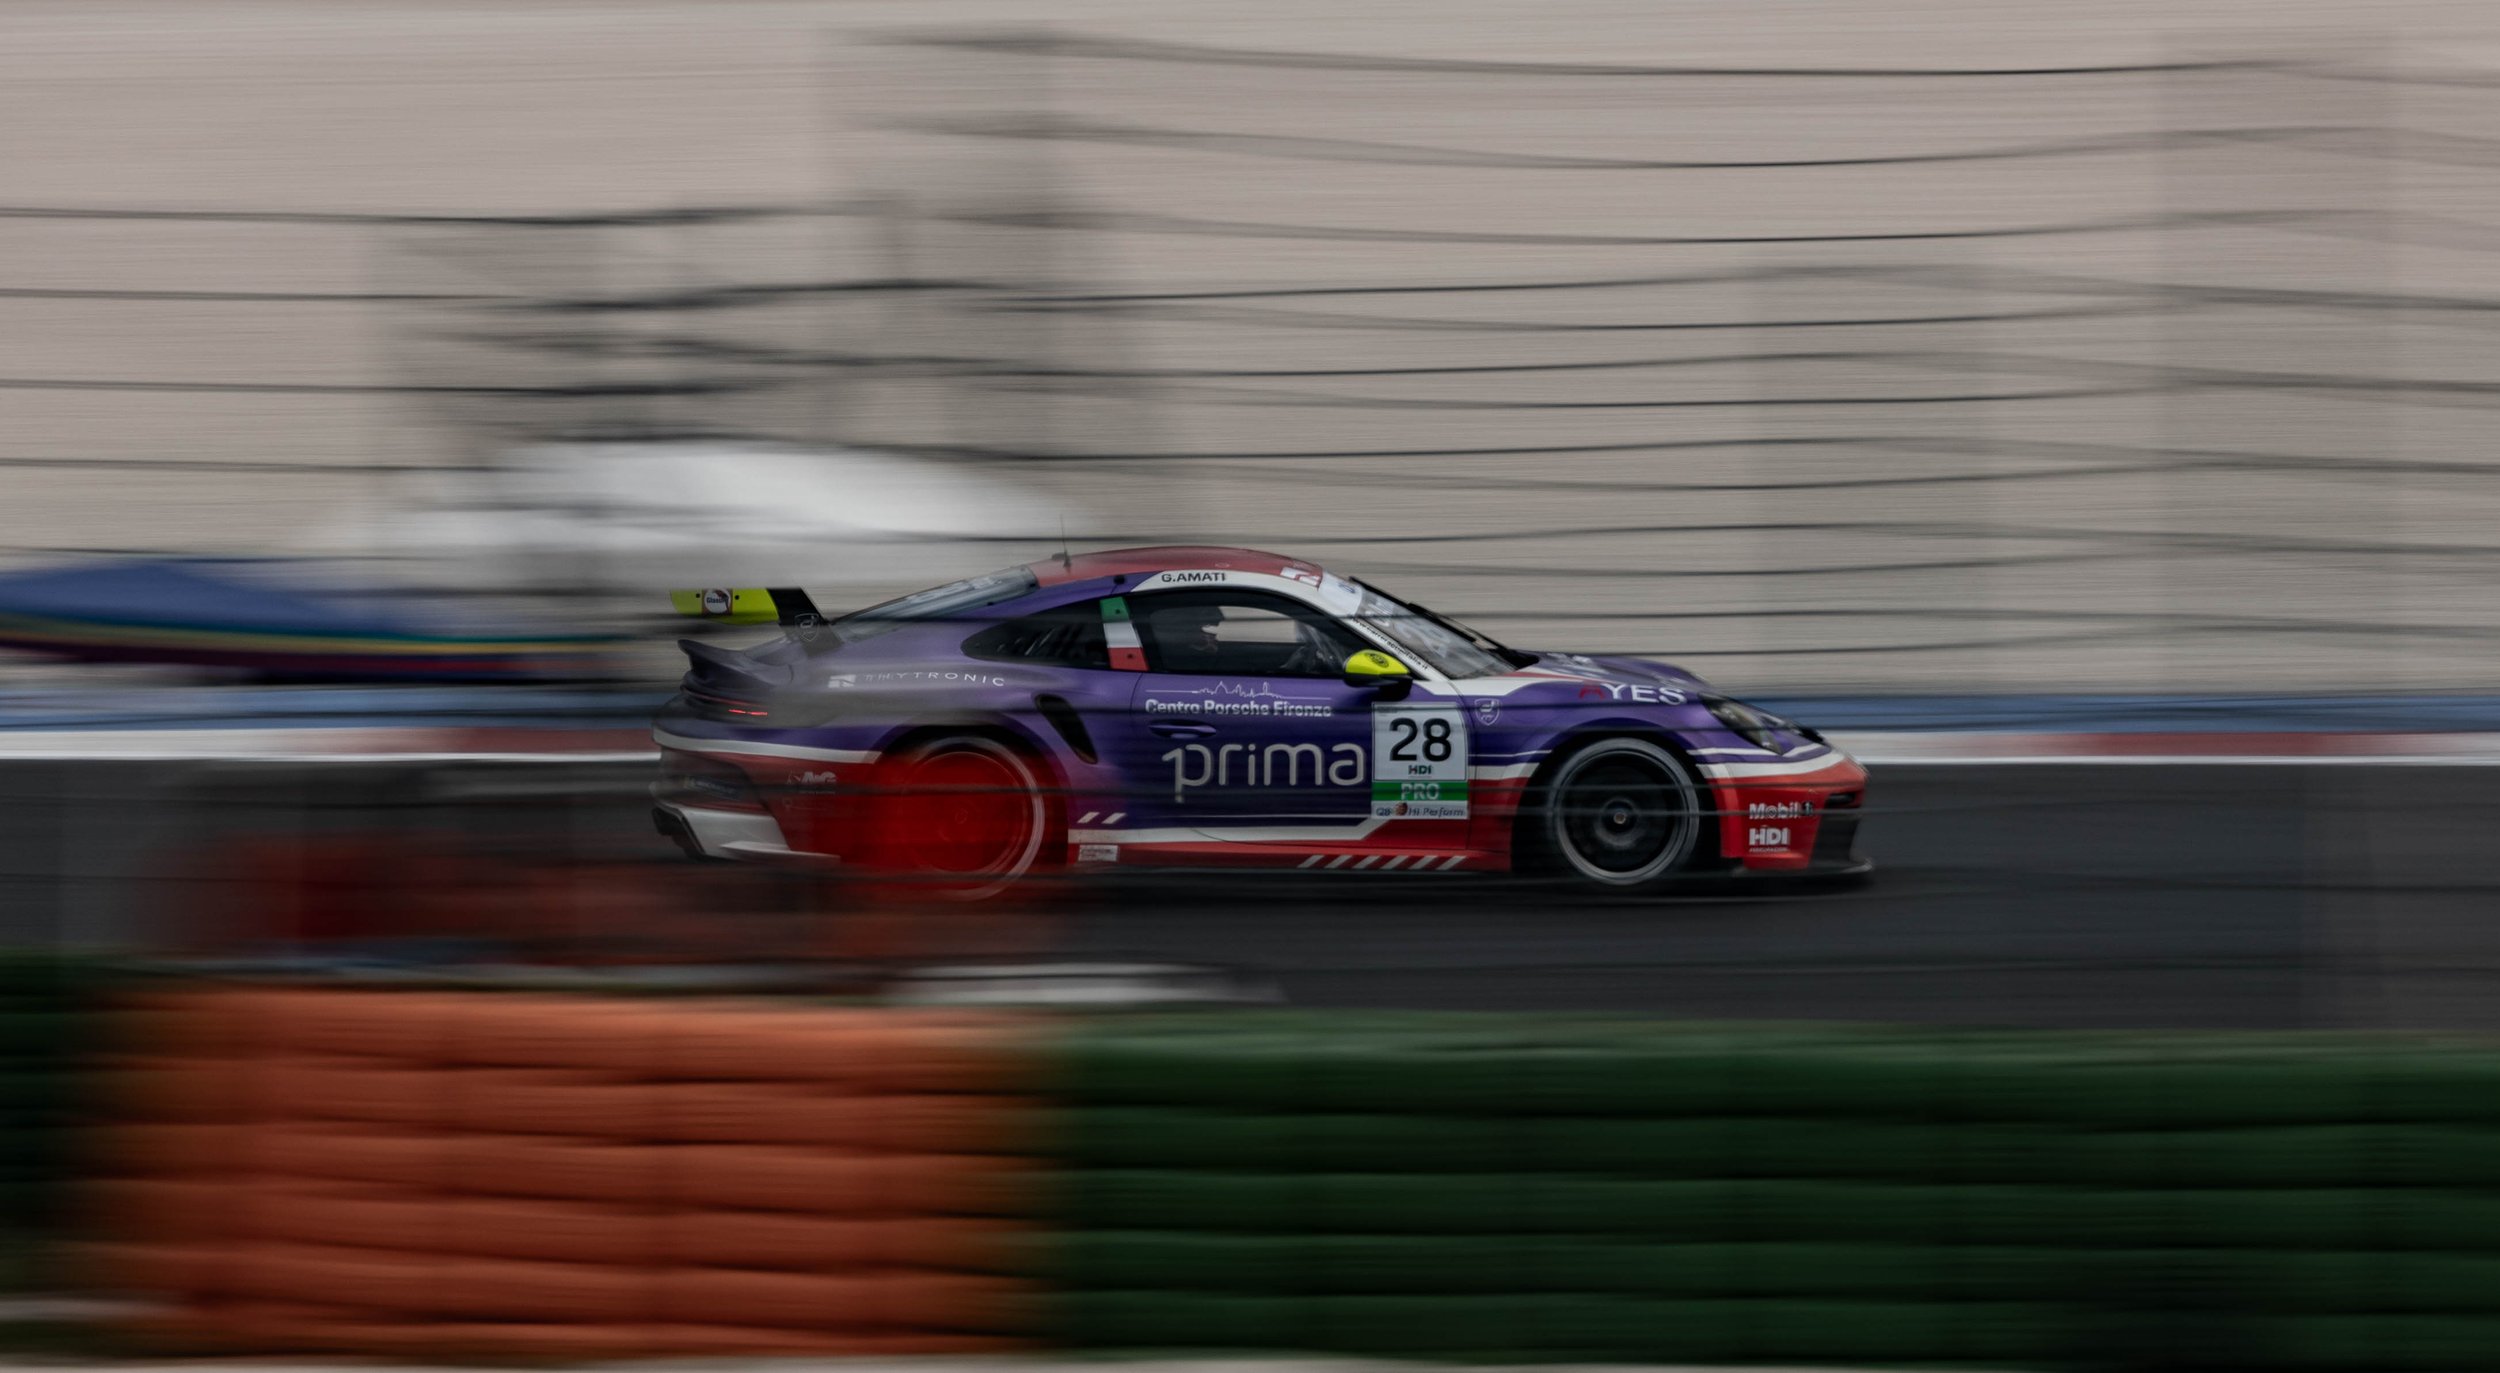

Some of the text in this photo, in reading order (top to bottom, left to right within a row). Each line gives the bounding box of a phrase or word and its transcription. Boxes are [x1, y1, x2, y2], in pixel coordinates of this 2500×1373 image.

[1161, 572, 1226, 583] G.AMATI
[864, 671, 1005, 687] YTRONIC
[1144, 698, 1332, 718] Centro Porsche Firenze
[1389, 717, 1452, 762] 28
[1161, 742, 1368, 804] prima
[1408, 764, 1432, 775] HDI
[1400, 783, 1440, 801] PRO
[1748, 801, 1801, 820] Mobil
[1748, 827, 1791, 847] HDI
